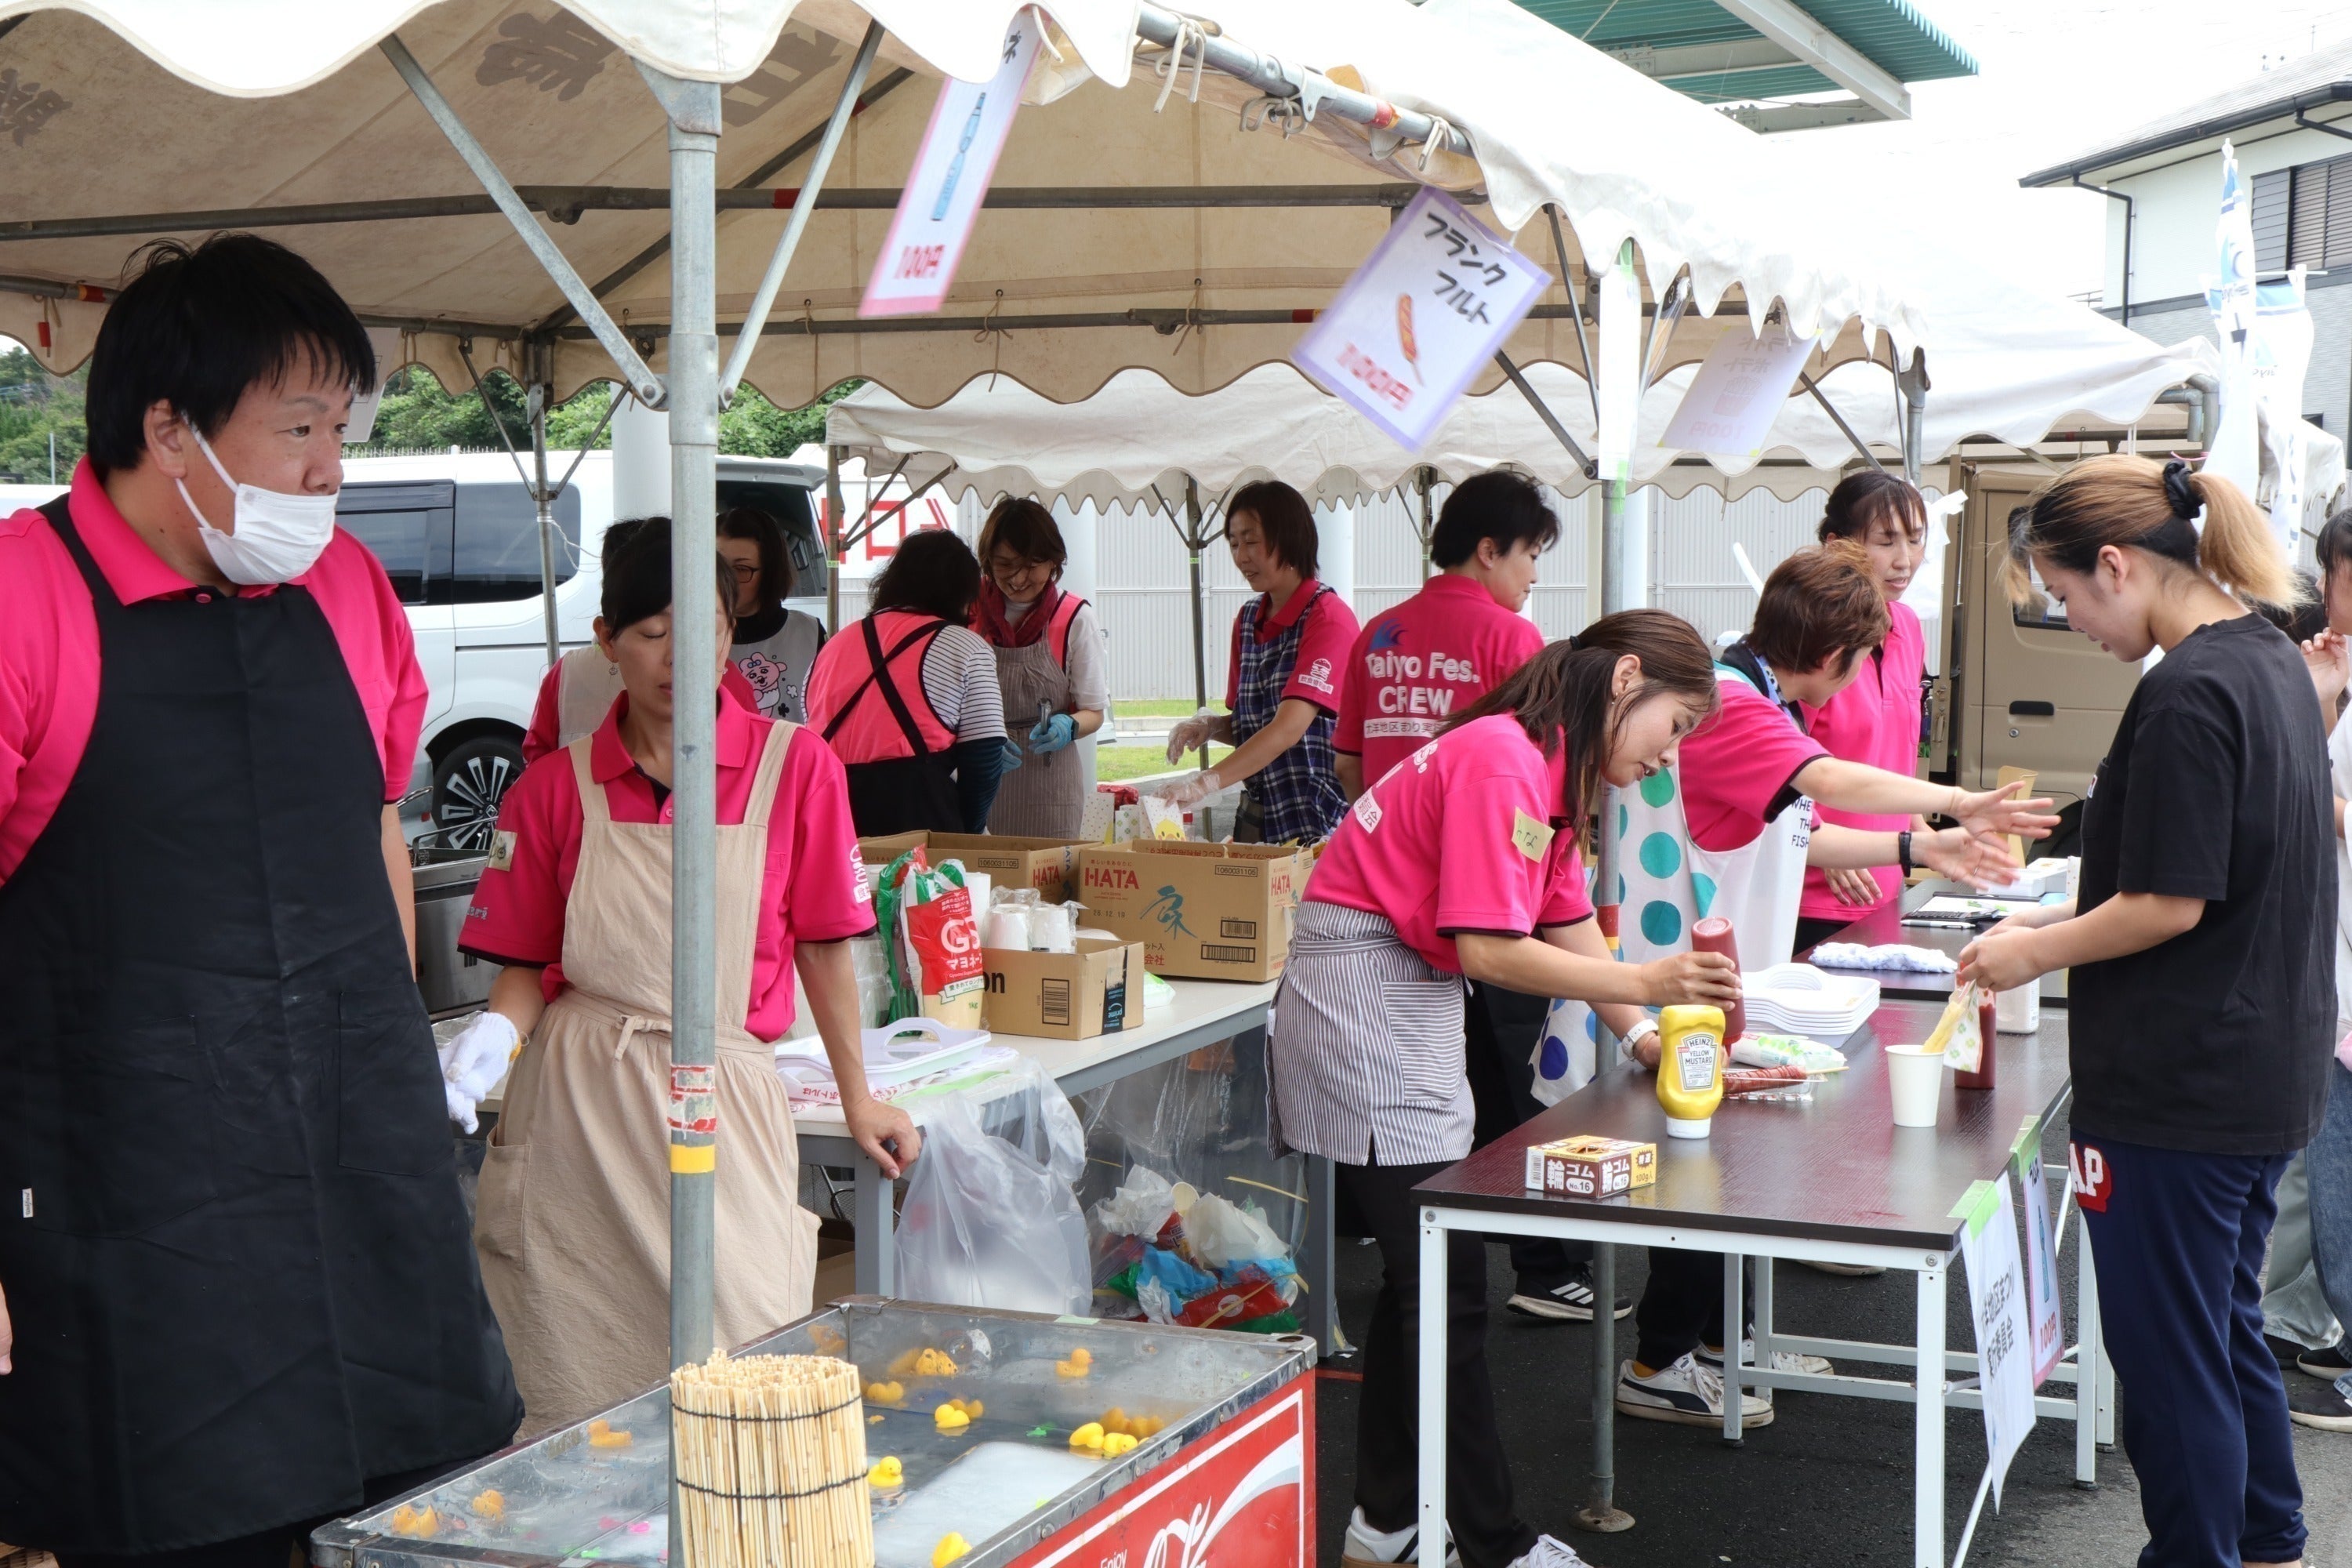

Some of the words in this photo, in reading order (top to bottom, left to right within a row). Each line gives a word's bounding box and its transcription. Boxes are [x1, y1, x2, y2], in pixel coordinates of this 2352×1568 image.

[1424, 211, 1507, 286] フランク
[1433, 269, 1491, 325] フルト
[1337, 343, 1414, 412] 100円
[1428, 652, 1481, 683] Fes.
[1378, 685, 1454, 716] CREW
[1800, 818, 1811, 830] TH
[1033, 866, 1060, 887] HATA
[1084, 867, 1139, 889] HATA
[1271, 874, 1290, 896] HATA
[1144, 953, 1165, 966] 会社
[1689, 1037, 1711, 1047] HEINZ
[1685, 1056, 1712, 1065] MUSTARD
[1546, 1159, 1595, 1191] 輪ゴム
[1602, 1158, 1630, 1194] 輪ゴム
[2070, 1142, 2103, 1197] AP
